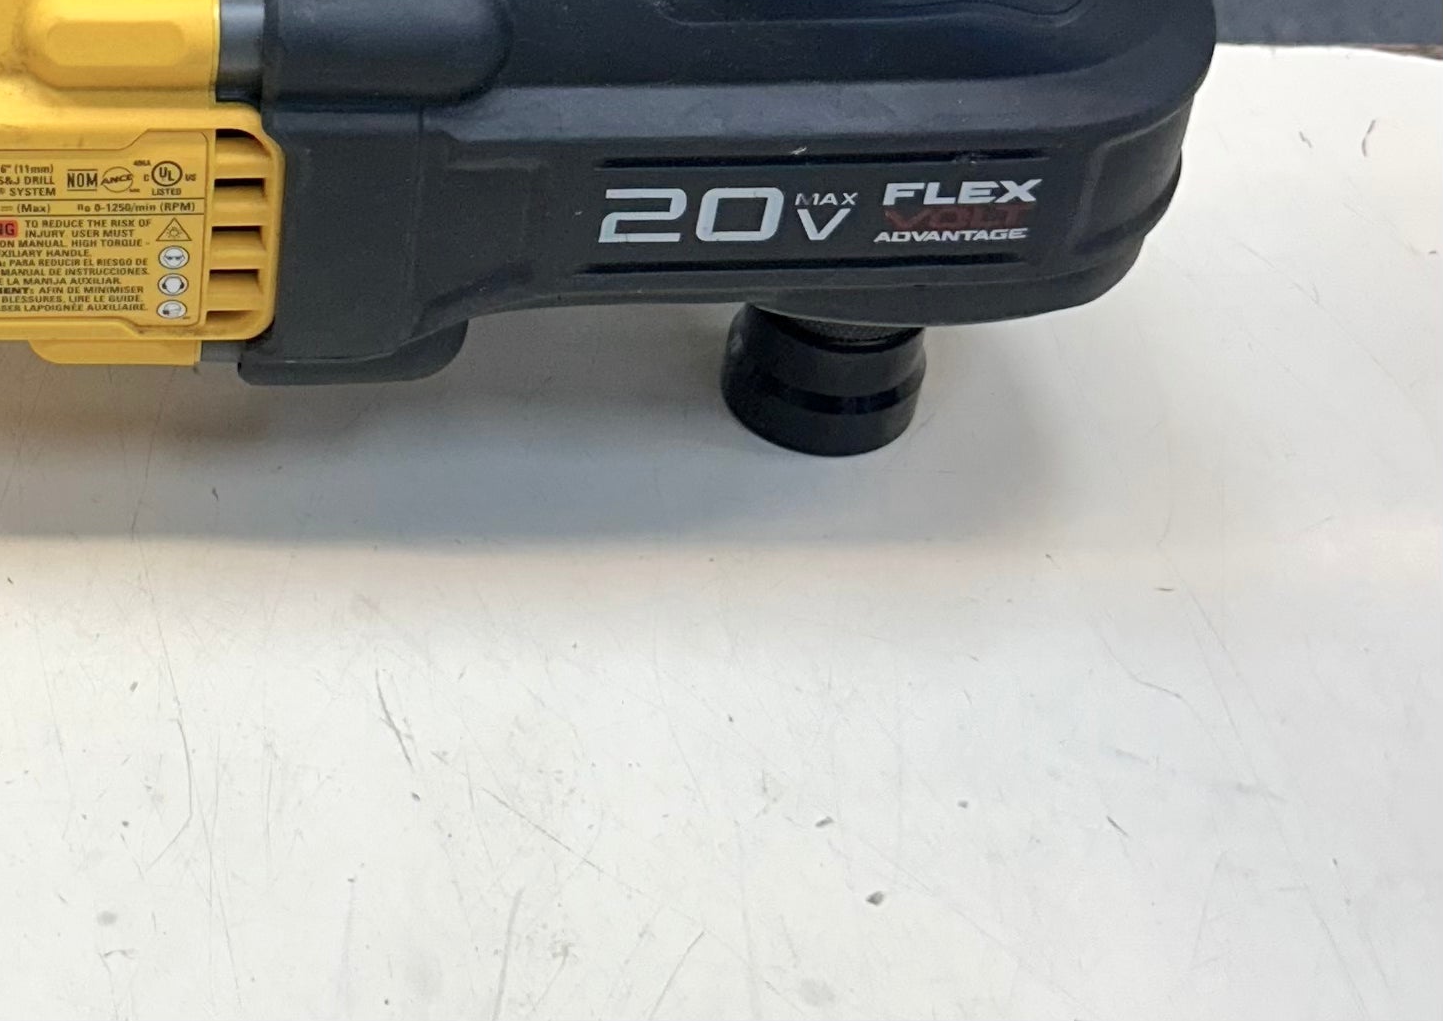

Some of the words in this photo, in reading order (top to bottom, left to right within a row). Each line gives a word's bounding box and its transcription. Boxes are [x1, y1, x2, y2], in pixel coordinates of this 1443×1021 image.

[15, 164, 54, 174] (11mm)
[24, 176, 55, 185] DRILL
[67, 173, 98, 188] NOM
[9, 187, 56, 196] SYSTEM
[151, 188, 182, 196] LISTED
[882, 179, 1043, 206] FLEX
[795, 192, 858, 206] MAX
[16, 203, 51, 213] (Max)
[160, 202, 196, 212] (RPM)
[884, 203, 1037, 231] VOLT
[25, 220, 39, 228] TO
[42, 220, 84, 228] REDUCE
[87, 219, 107, 227] THE
[110, 219, 135, 227] RISK
[138, 219, 152, 227] OF
[71, 229, 100, 237] USER
[103, 229, 135, 237] MUST
[873, 228, 1029, 243] ADVANTAGE
[100, 239, 143, 247] TORQUE
[9, 259, 36, 267] PARA
[38, 259, 81, 267] REDUCIR
[96, 258, 133, 266] RIESGO
[135, 258, 149, 266] DE
[0, 268, 46, 276] MANUAL
[48, 268, 63, 276] DE
[23, 277, 67, 285] MANIJA
[38, 286, 64, 294] AFIN
[67, 286, 80, 294] DE
[83, 286, 144, 294] MINIMISER
[68, 295, 90, 303] LIRE
